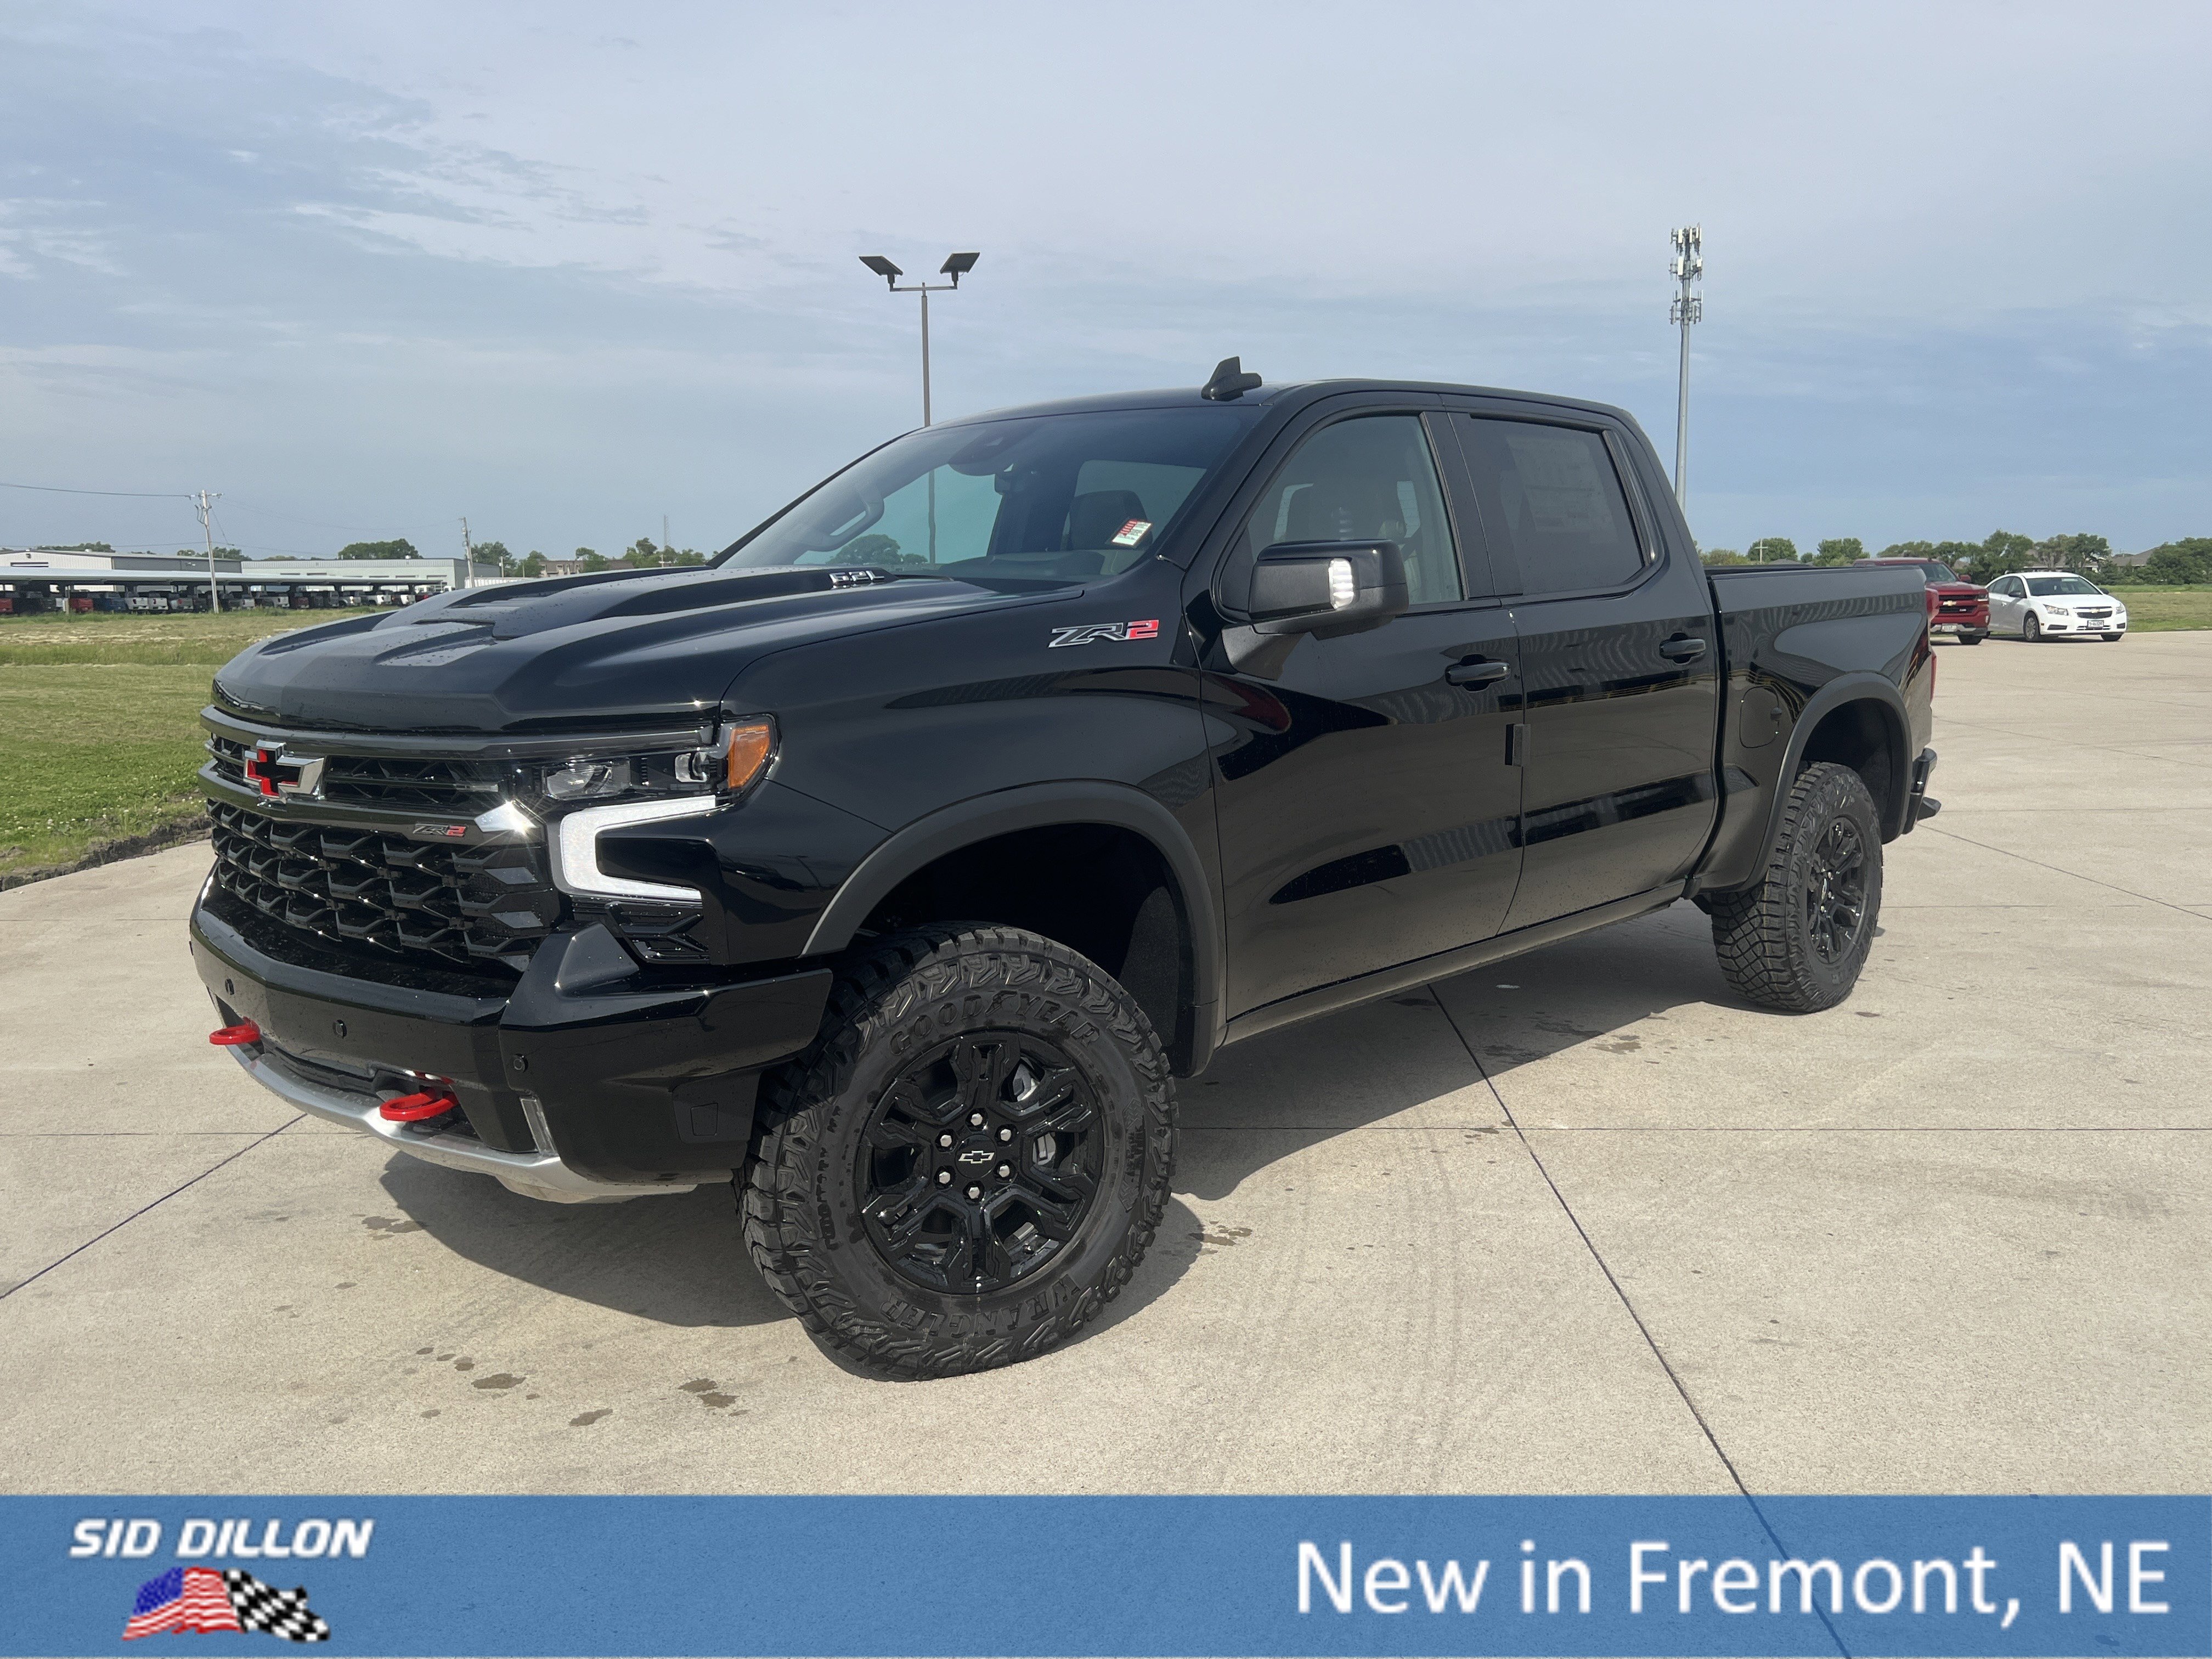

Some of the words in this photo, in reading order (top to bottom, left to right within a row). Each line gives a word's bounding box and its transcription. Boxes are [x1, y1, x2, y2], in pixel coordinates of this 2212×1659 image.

[1048, 619, 1159, 648] ZR2
[413, 823, 466, 837] ZR2
[889, 990, 1100, 1056] GOODYEAR
[880, 1273, 1081, 1339] WRANGLER
